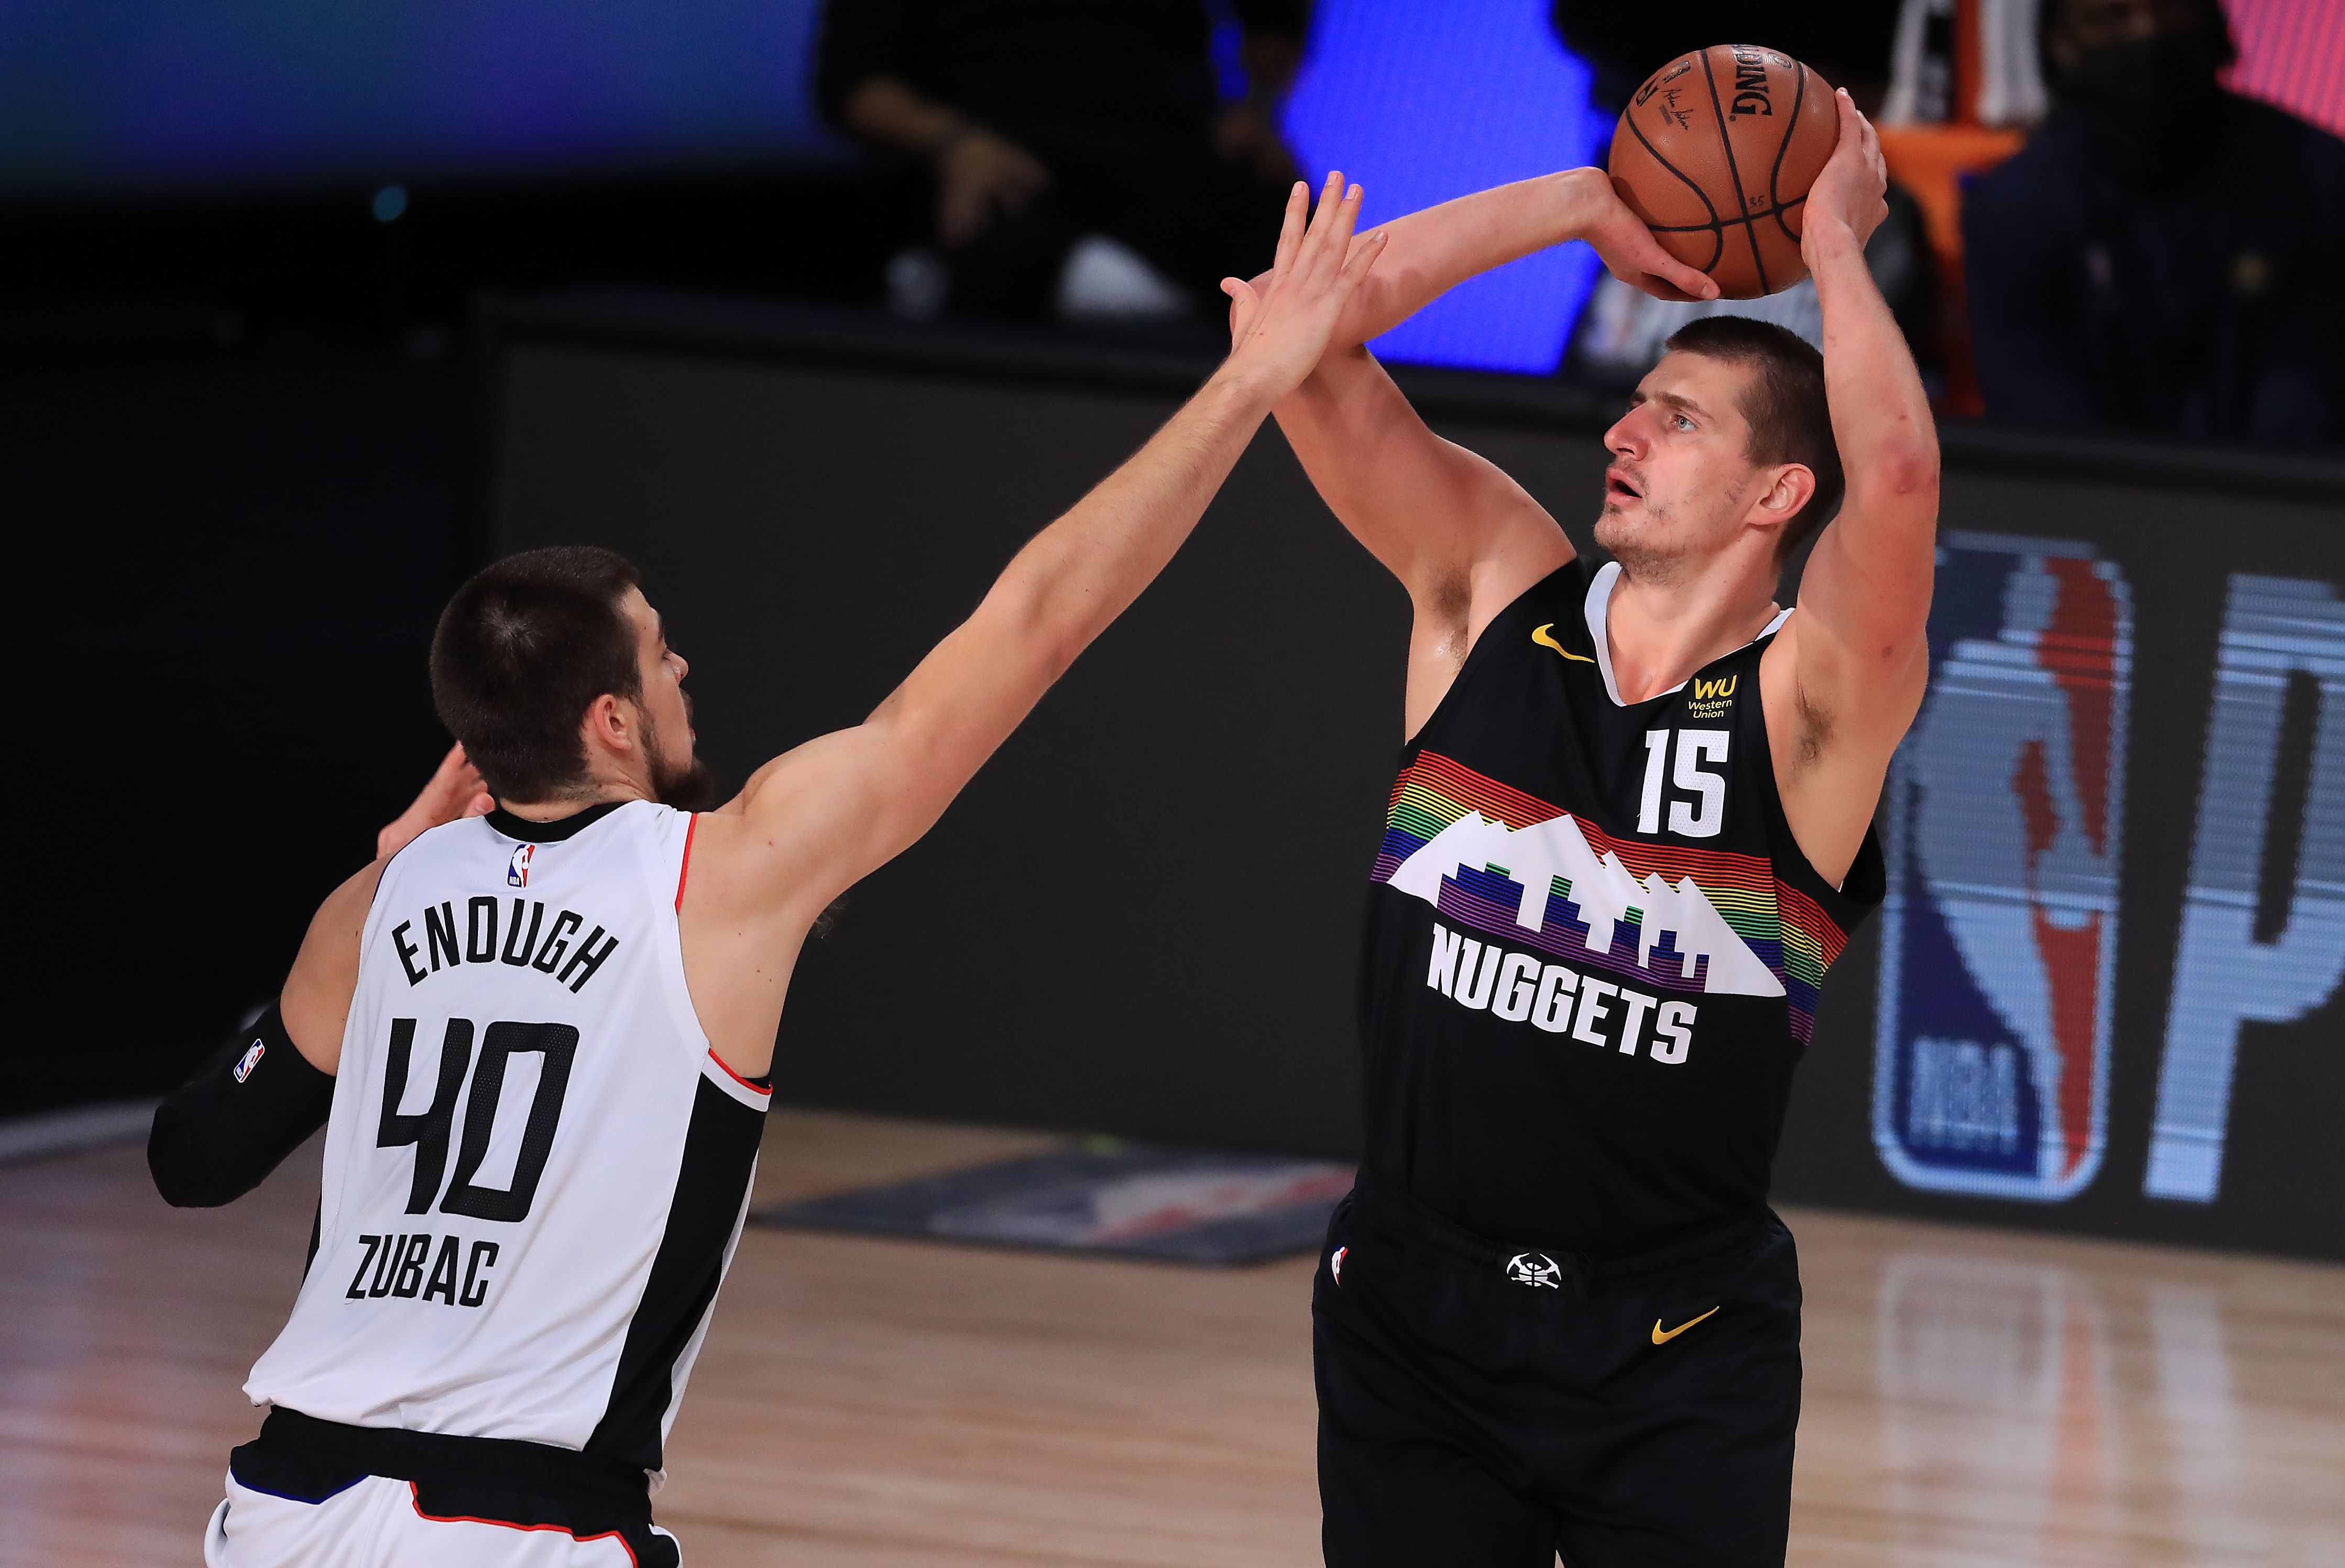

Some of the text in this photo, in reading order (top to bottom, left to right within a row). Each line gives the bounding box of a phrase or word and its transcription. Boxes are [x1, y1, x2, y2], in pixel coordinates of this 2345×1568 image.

[1688, 699, 1732, 710] Western
[1693, 709, 1724, 718] Union
[1695, 675, 1737, 699] WU
[1636, 728, 1730, 838] 15
[509, 875, 520, 886] NBA
[2142, 573, 2345, 1203] P
[391, 896, 620, 994] ENOUGH
[1426, 922, 1698, 1065] NUGGETS
[376, 1017, 580, 1223] 40
[345, 1233, 500, 1308] ZUBAC
